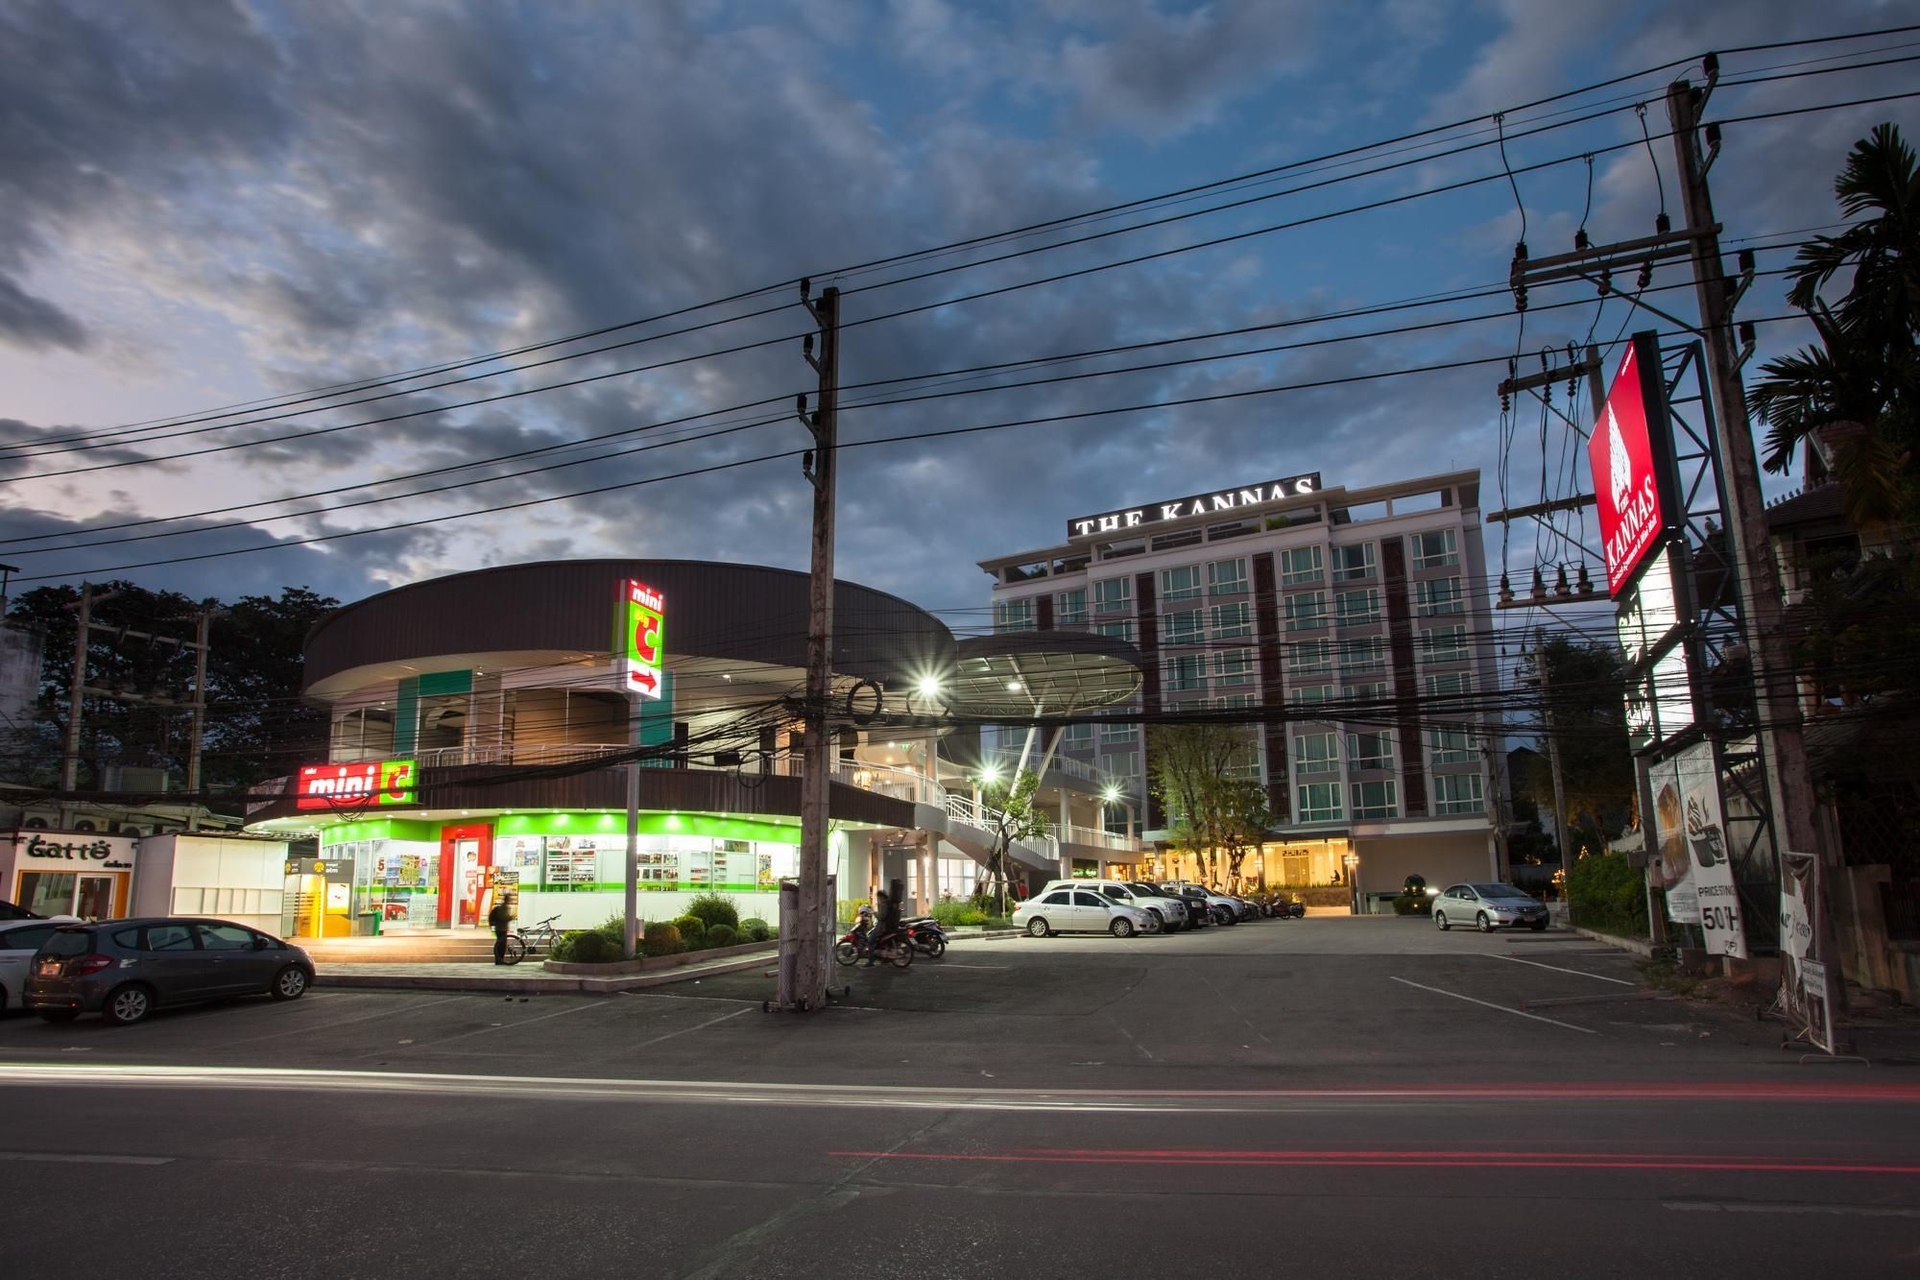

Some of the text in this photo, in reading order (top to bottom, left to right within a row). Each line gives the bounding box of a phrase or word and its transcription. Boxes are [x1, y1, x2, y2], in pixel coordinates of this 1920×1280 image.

[1075, 478, 1314, 536] THE KANNAS
[1606, 474, 1655, 574] KANNAS
[632, 588, 663, 612] mini
[634, 609, 650, 628] Big
[635, 615, 660, 663] C
[308, 766, 376, 799] mini
